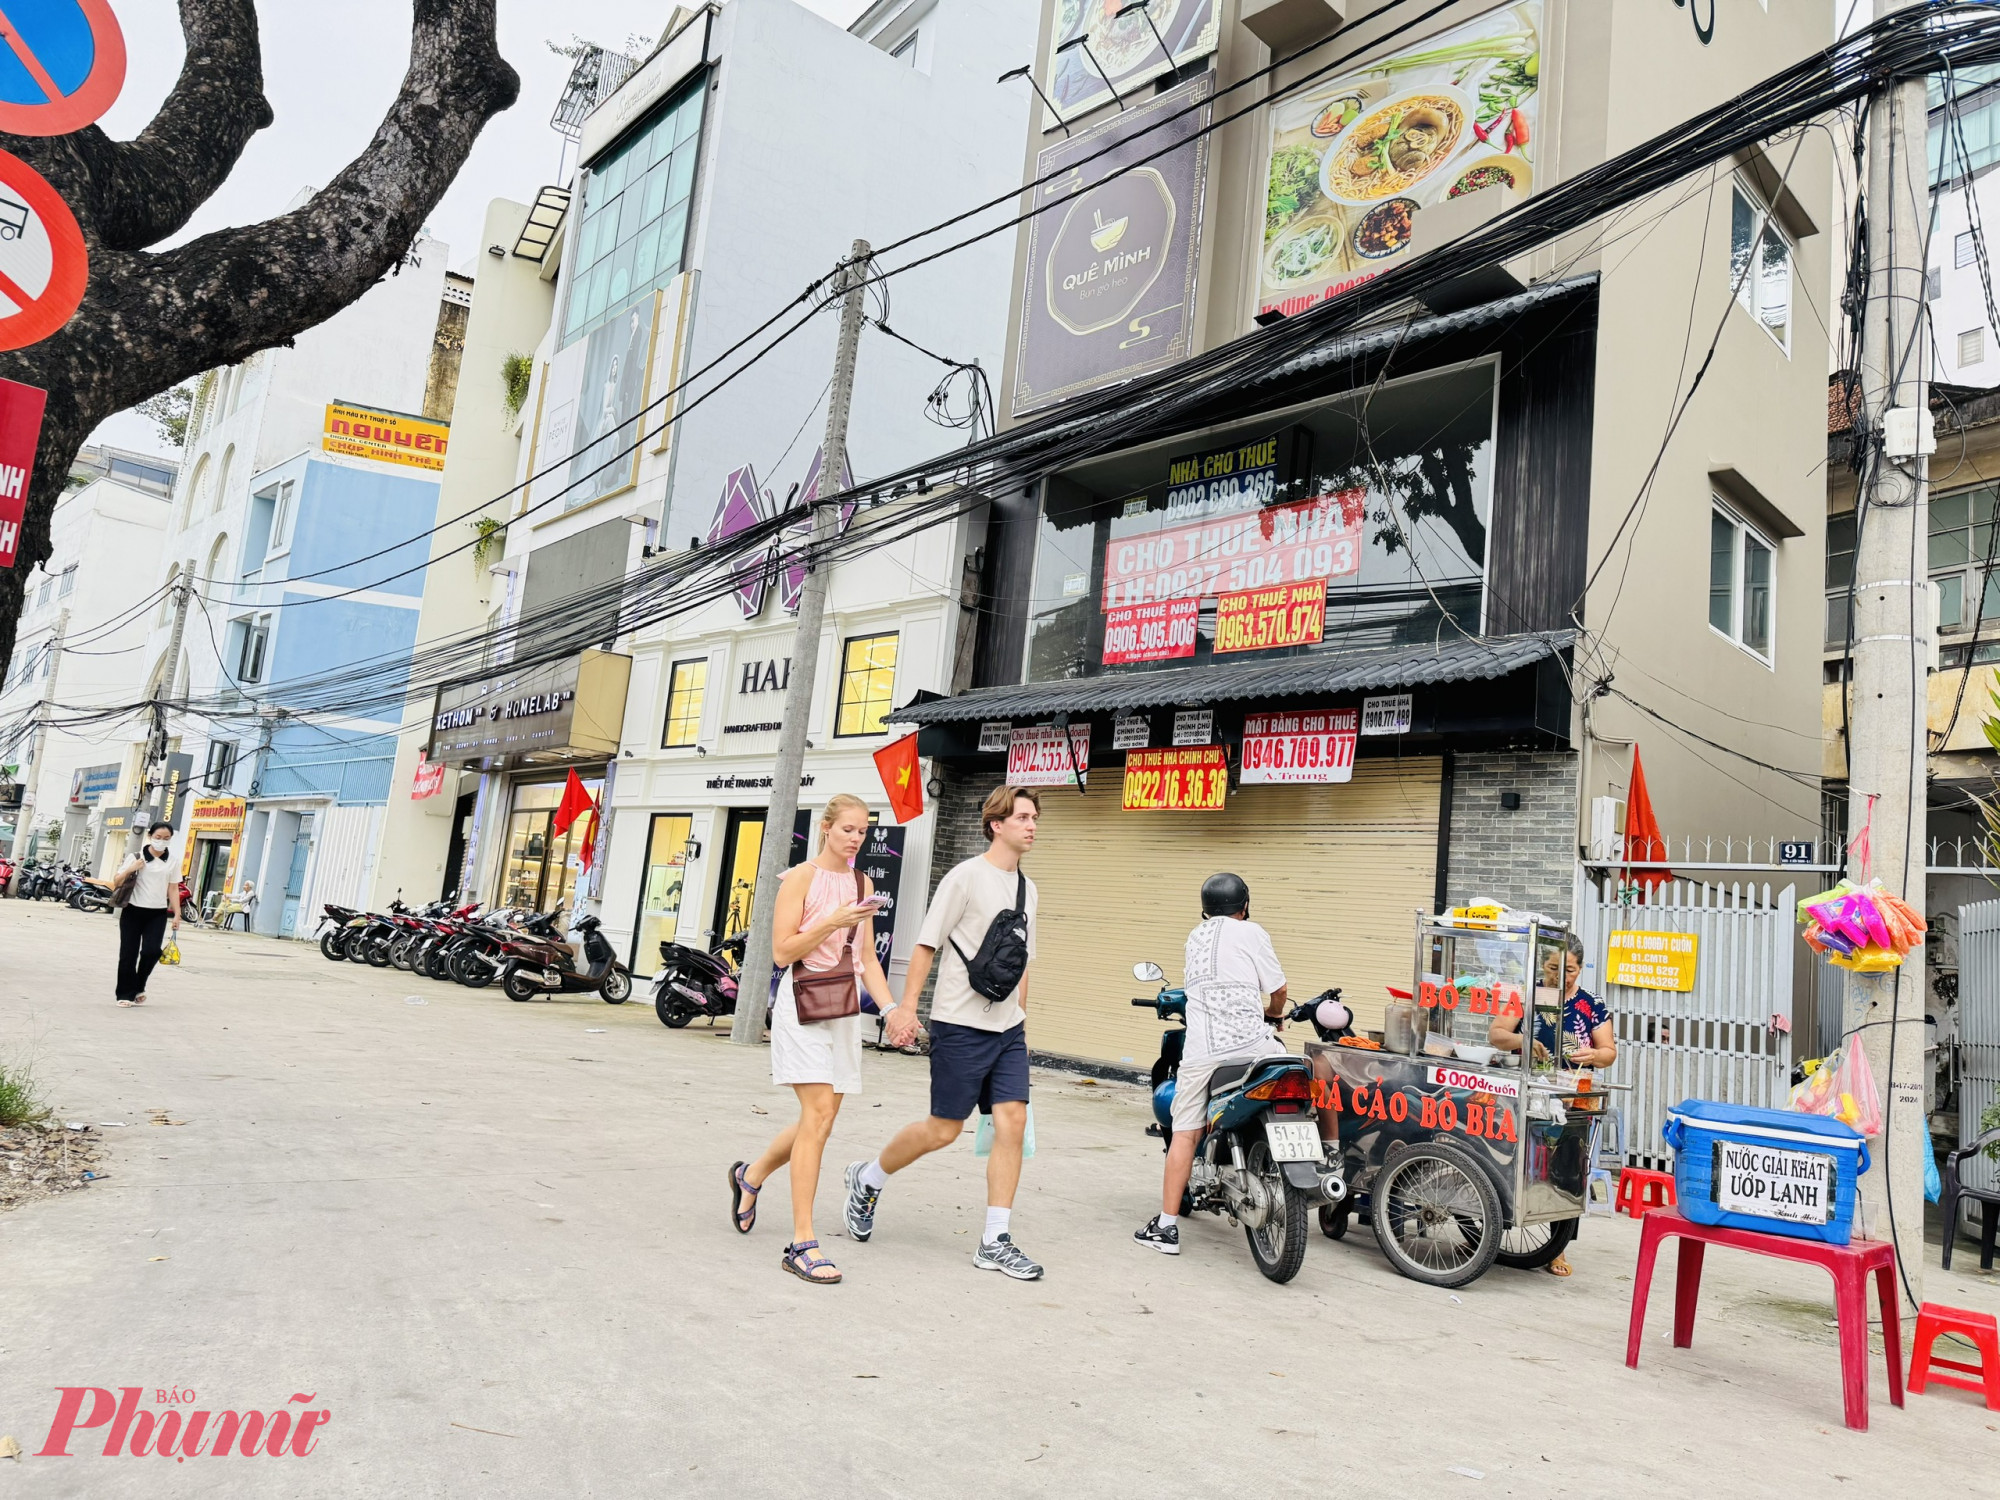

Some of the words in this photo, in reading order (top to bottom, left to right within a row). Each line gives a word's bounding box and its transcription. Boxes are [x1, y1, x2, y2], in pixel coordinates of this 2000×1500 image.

[1063, 262, 1099, 290] QUÊ
[1103, 246, 1151, 276] MÌNH
[1169, 460, 1198, 485] NHÀ
[1204, 452, 1233, 478] CHO
[1239, 437, 1277, 470] THUÊ
[1117, 538, 1175, 575] CHO
[1184, 515, 1261, 566] THUÊ
[1273, 498, 1346, 546] NHÀ
[1229, 554, 1282, 591] 504
[1293, 540, 1353, 581] 093
[1219, 595, 1248, 613] CHO
[1252, 588, 1288, 609] THUÊ
[1291, 583, 1323, 602] NHÀ
[1108, 610, 1132, 623] CHO
[1136, 604, 1167, 620] THUÊ
[1170, 600, 1197, 615] NHÀ
[1105, 616, 1196, 653] 0906.905.006
[1216, 605, 1321, 650] 0963.570.974
[1368, 700, 1380, 709] CHO
[1381, 697, 1396, 707] THUÊ
[723, 722, 773, 734] HANDCRAFTED
[1012, 730, 1024, 740] Cho
[1026, 729, 1040, 739] thuê
[1041, 728, 1053, 739] nhà
[1070, 725, 1090, 737] doanh
[1117, 727, 1135, 735] CHÍNH
[1177, 722, 1196, 730] CHÍNH
[1245, 718, 1269, 737] MẶT
[1271, 712, 1300, 734] BẰNG
[1302, 716, 1325, 731] CHO
[1328, 711, 1356, 731] THUÊ
[1128, 753, 1142, 767] CHO
[1144, 749, 1161, 765] THUÊ
[1163, 748, 1177, 765] NHÀ
[1180, 747, 1201, 764] CHÍNH
[1203, 745, 1220, 764] CHỦ
[1242, 735, 1356, 769] 0946.709.977
[735, 778, 759, 788] TRANG
[1124, 768, 1227, 808] 0922.16.36.36
[871, 843, 887, 853] HAR
[1785, 844, 1808, 858] 91
[1618, 973, 1636, 984] 033
[1638, 975, 1680, 988] 4443292
[1656, 965, 1680, 976] 6297
[1418, 977, 1459, 1010] BÒ
[1469, 982, 1524, 1019] BÍA
[1352, 1075, 1408, 1123] CẢO
[1420, 1091, 1458, 1131] BÒ
[1465, 1100, 1518, 1143] BÍA
[1278, 1142, 1316, 1158] 3312
[1725, 1146, 1759, 1172] NƯỚC
[1762, 1151, 1788, 1176] GIẢI
[1790, 1157, 1826, 1181] KHÁT
[1731, 1172, 1766, 1198] ƯỚP
[1770, 1181, 1818, 1209] LẠNH
